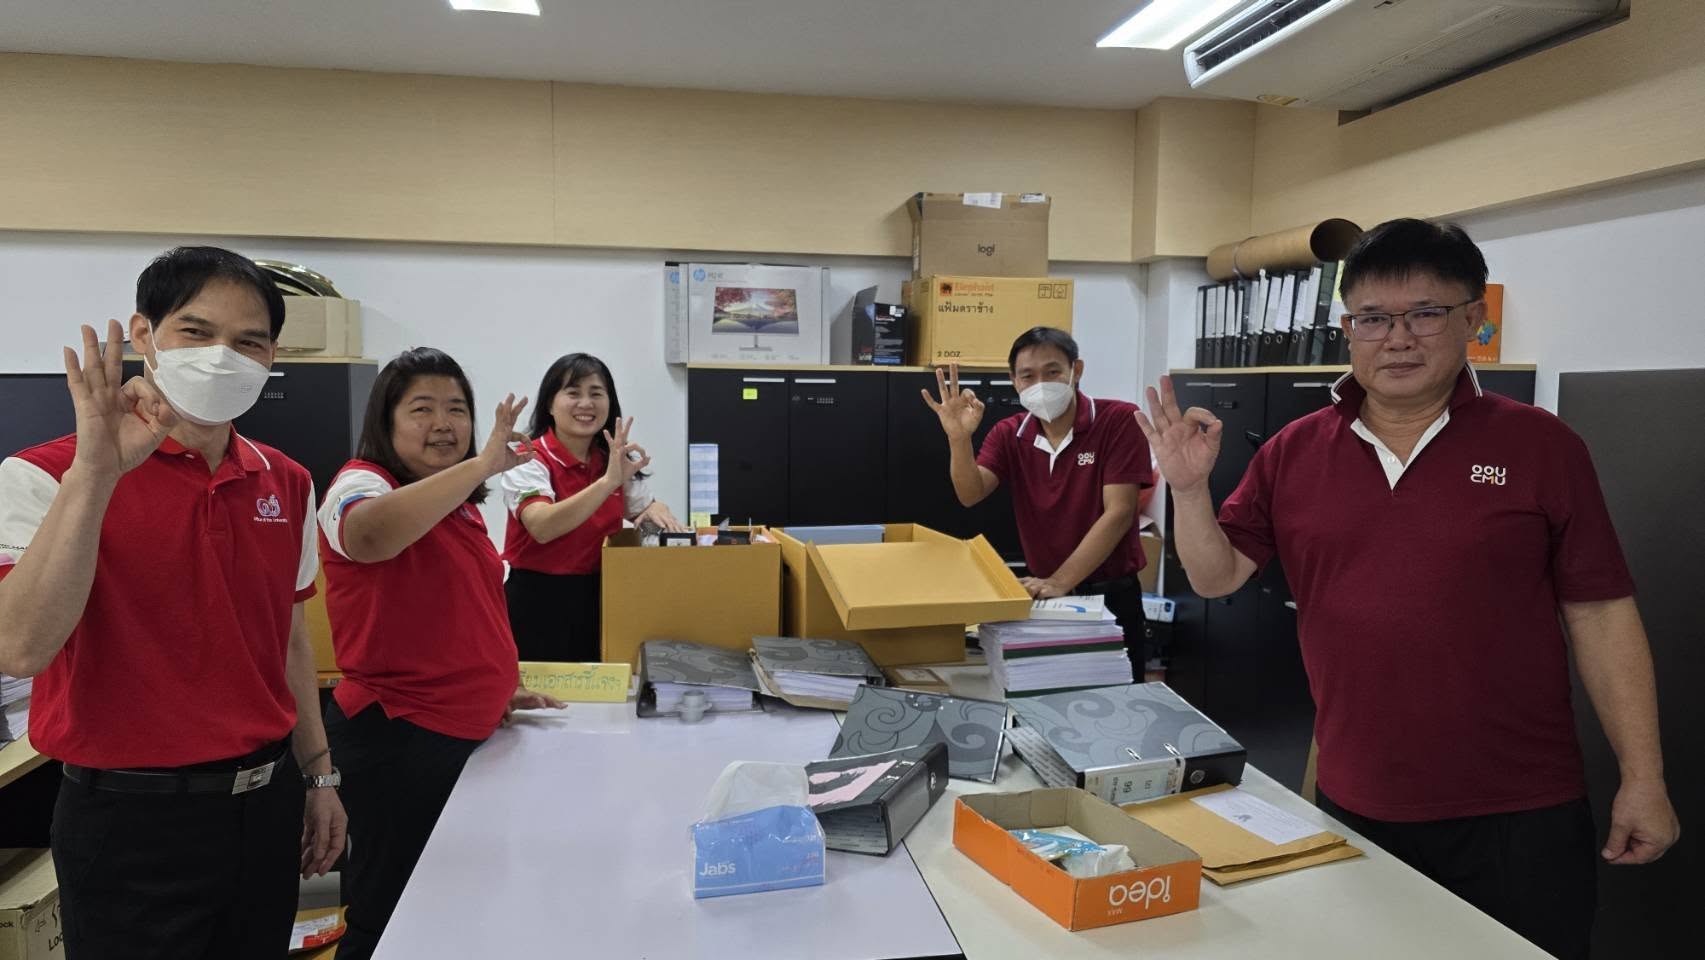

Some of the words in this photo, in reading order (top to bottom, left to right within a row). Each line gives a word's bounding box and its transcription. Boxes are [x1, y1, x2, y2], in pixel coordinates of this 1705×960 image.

[977, 244, 996, 257] logi
[1472, 464, 1506, 477] OOU
[1470, 473, 1506, 485] CMU
[699, 861, 736, 876] Jabs
[1109, 875, 1172, 910] idea
